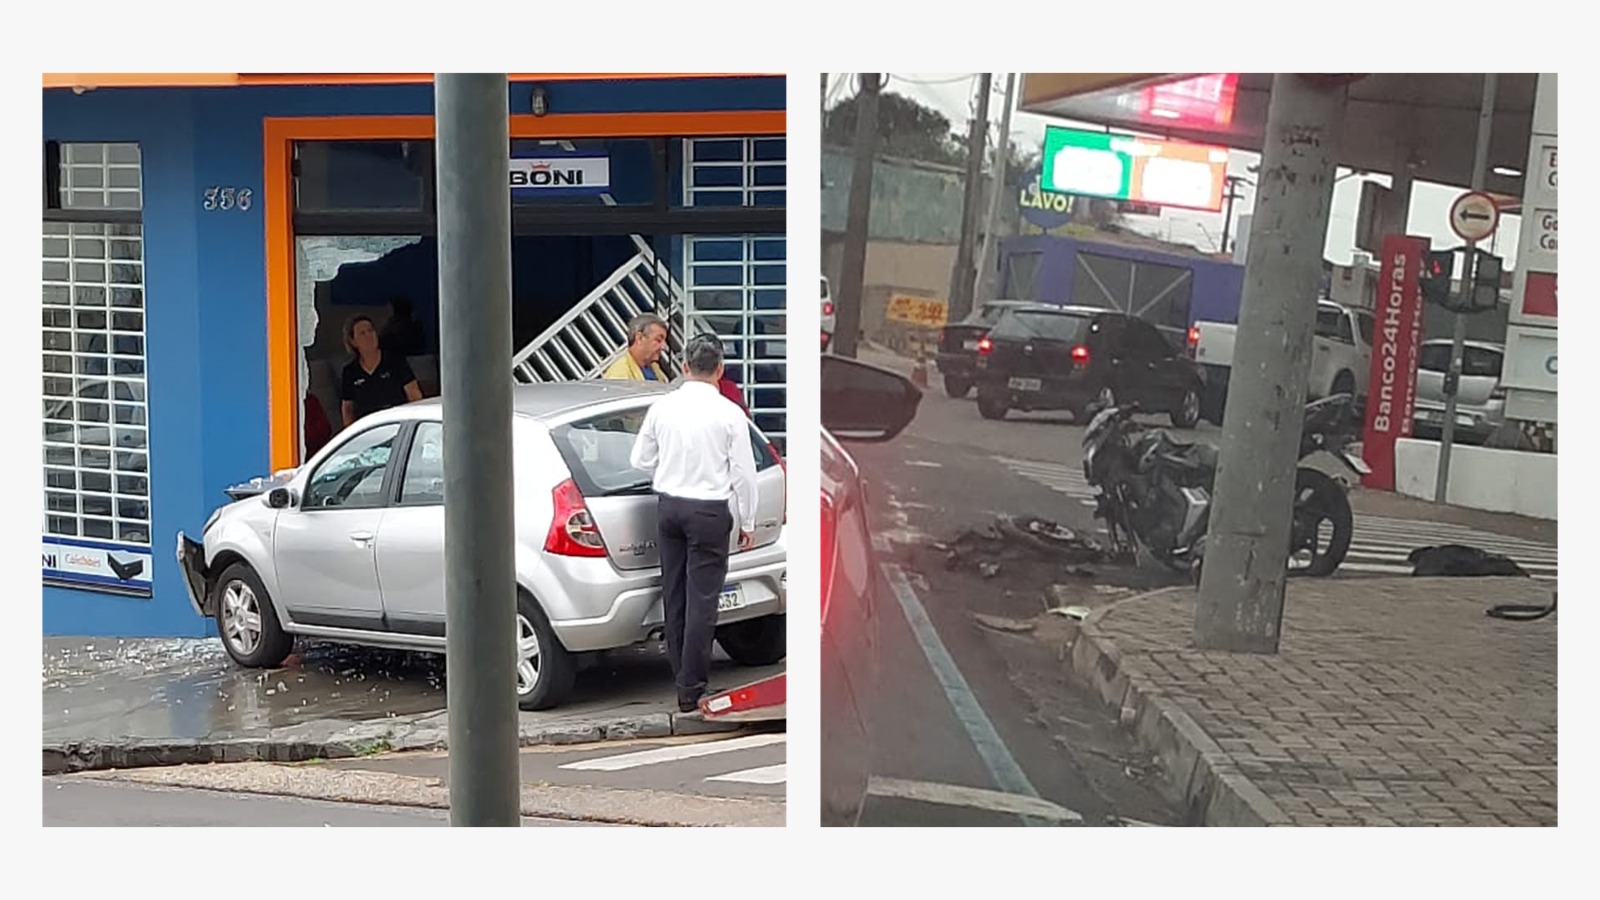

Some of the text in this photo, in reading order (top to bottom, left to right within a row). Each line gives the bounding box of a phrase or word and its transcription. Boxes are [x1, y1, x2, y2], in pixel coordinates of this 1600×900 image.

[509, 169, 584, 185] BONI
[1020, 189, 1075, 213] LAVO!
[1374, 253, 1407, 431] Banco24Horas
